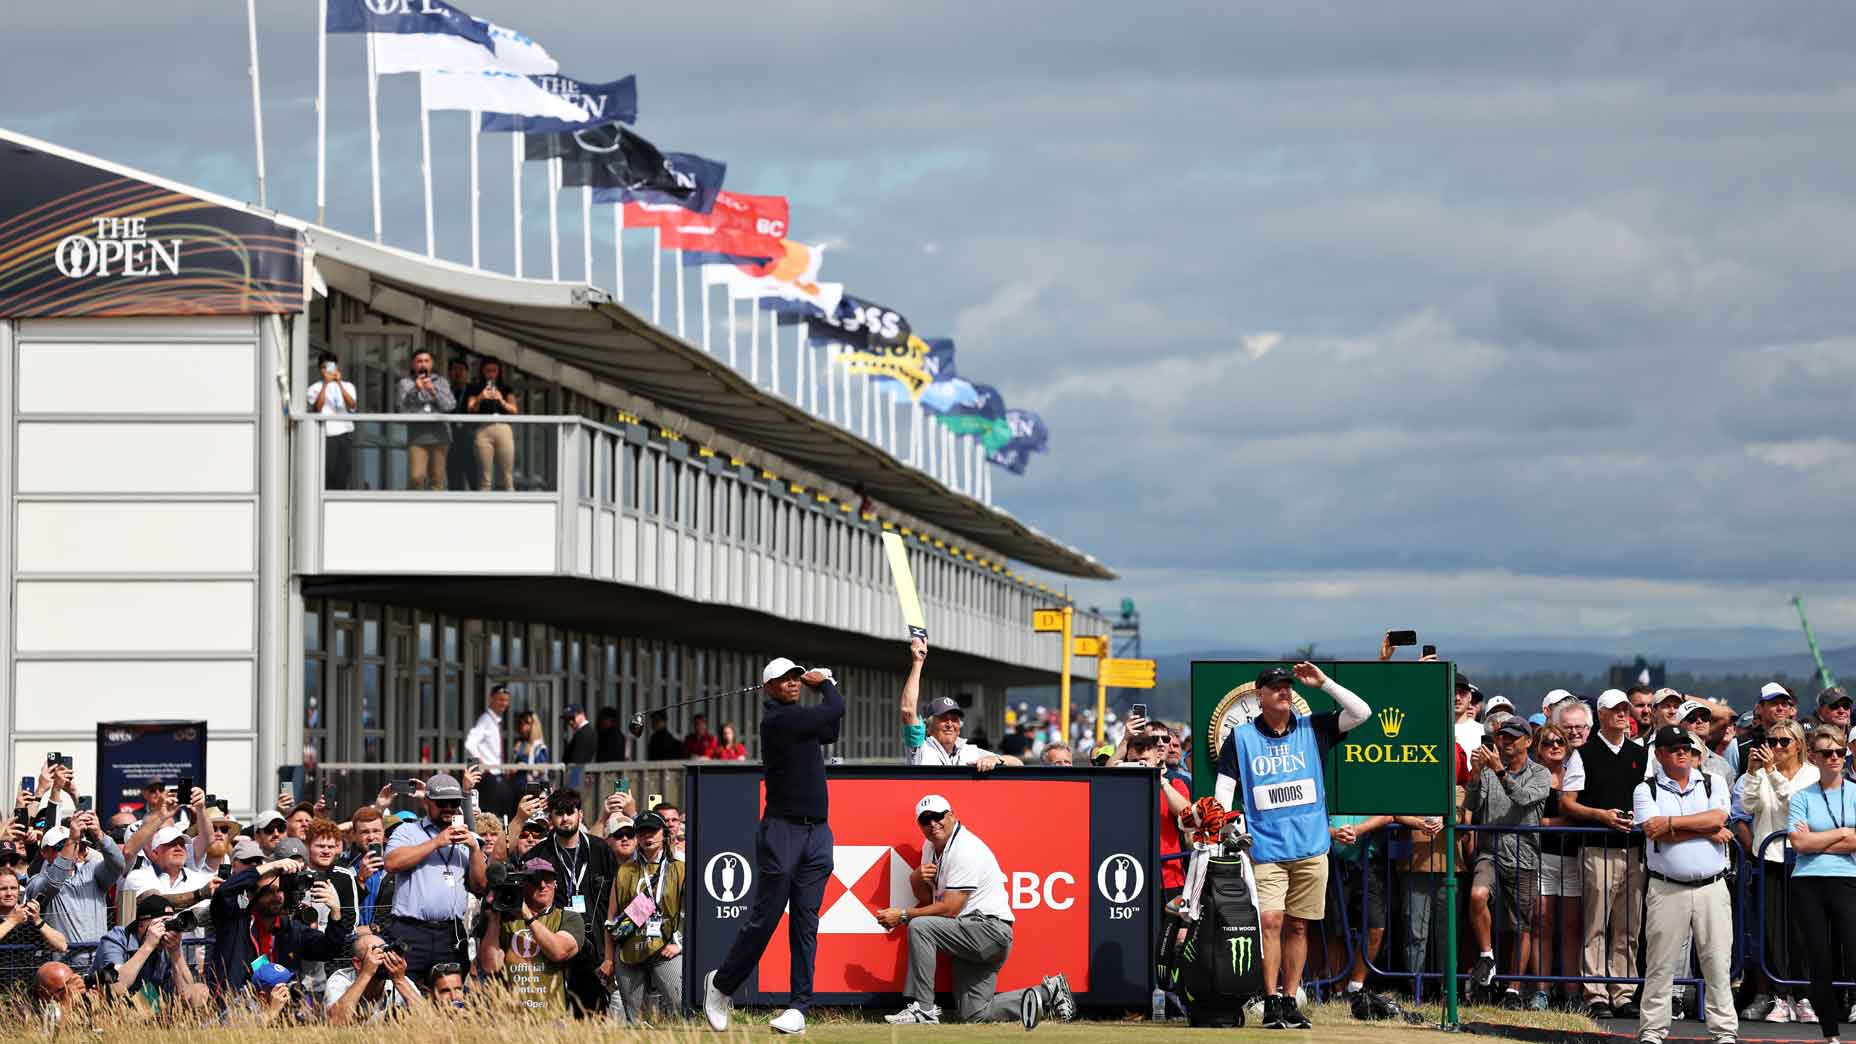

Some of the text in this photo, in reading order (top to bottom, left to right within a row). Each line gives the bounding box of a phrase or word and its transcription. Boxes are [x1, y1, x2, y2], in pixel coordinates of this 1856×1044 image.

[92, 217, 146, 238] THE
[756, 219, 784, 237] BC
[54, 235, 182, 278] OPEN
[1042, 614, 1055, 627] D
[1266, 744, 1289, 756] THE
[1344, 744, 1439, 763] ROLEX
[1252, 751, 1306, 777] OPEN
[1268, 784, 1304, 804] WOODS
[1000, 871, 1075, 911] BC
[513, 974, 540, 985] Open
